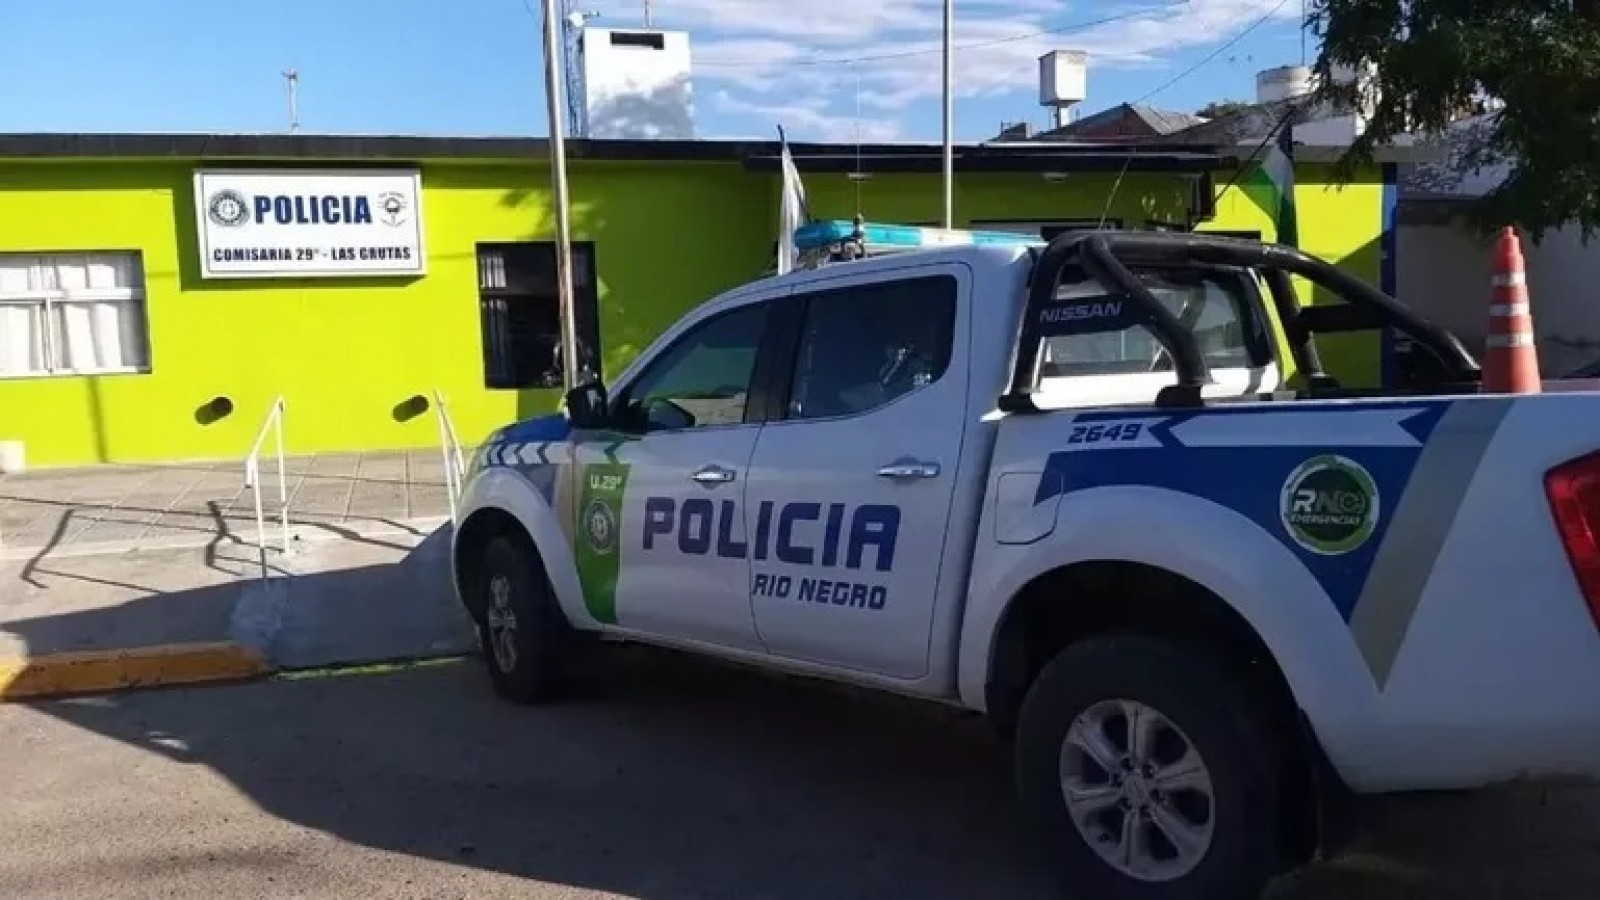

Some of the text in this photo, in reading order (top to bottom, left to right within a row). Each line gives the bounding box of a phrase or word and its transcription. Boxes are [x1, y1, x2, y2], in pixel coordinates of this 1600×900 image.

[253, 195, 373, 224] POLICIA
[213, 248, 292, 262] COMISARIA
[331, 247, 356, 260] LAS
[1040, 302, 1121, 322] NISSAN
[1068, 424, 1142, 443] 2649
[642, 497, 900, 571] POLICIA
[752, 573, 888, 611] RIO NEGRO
